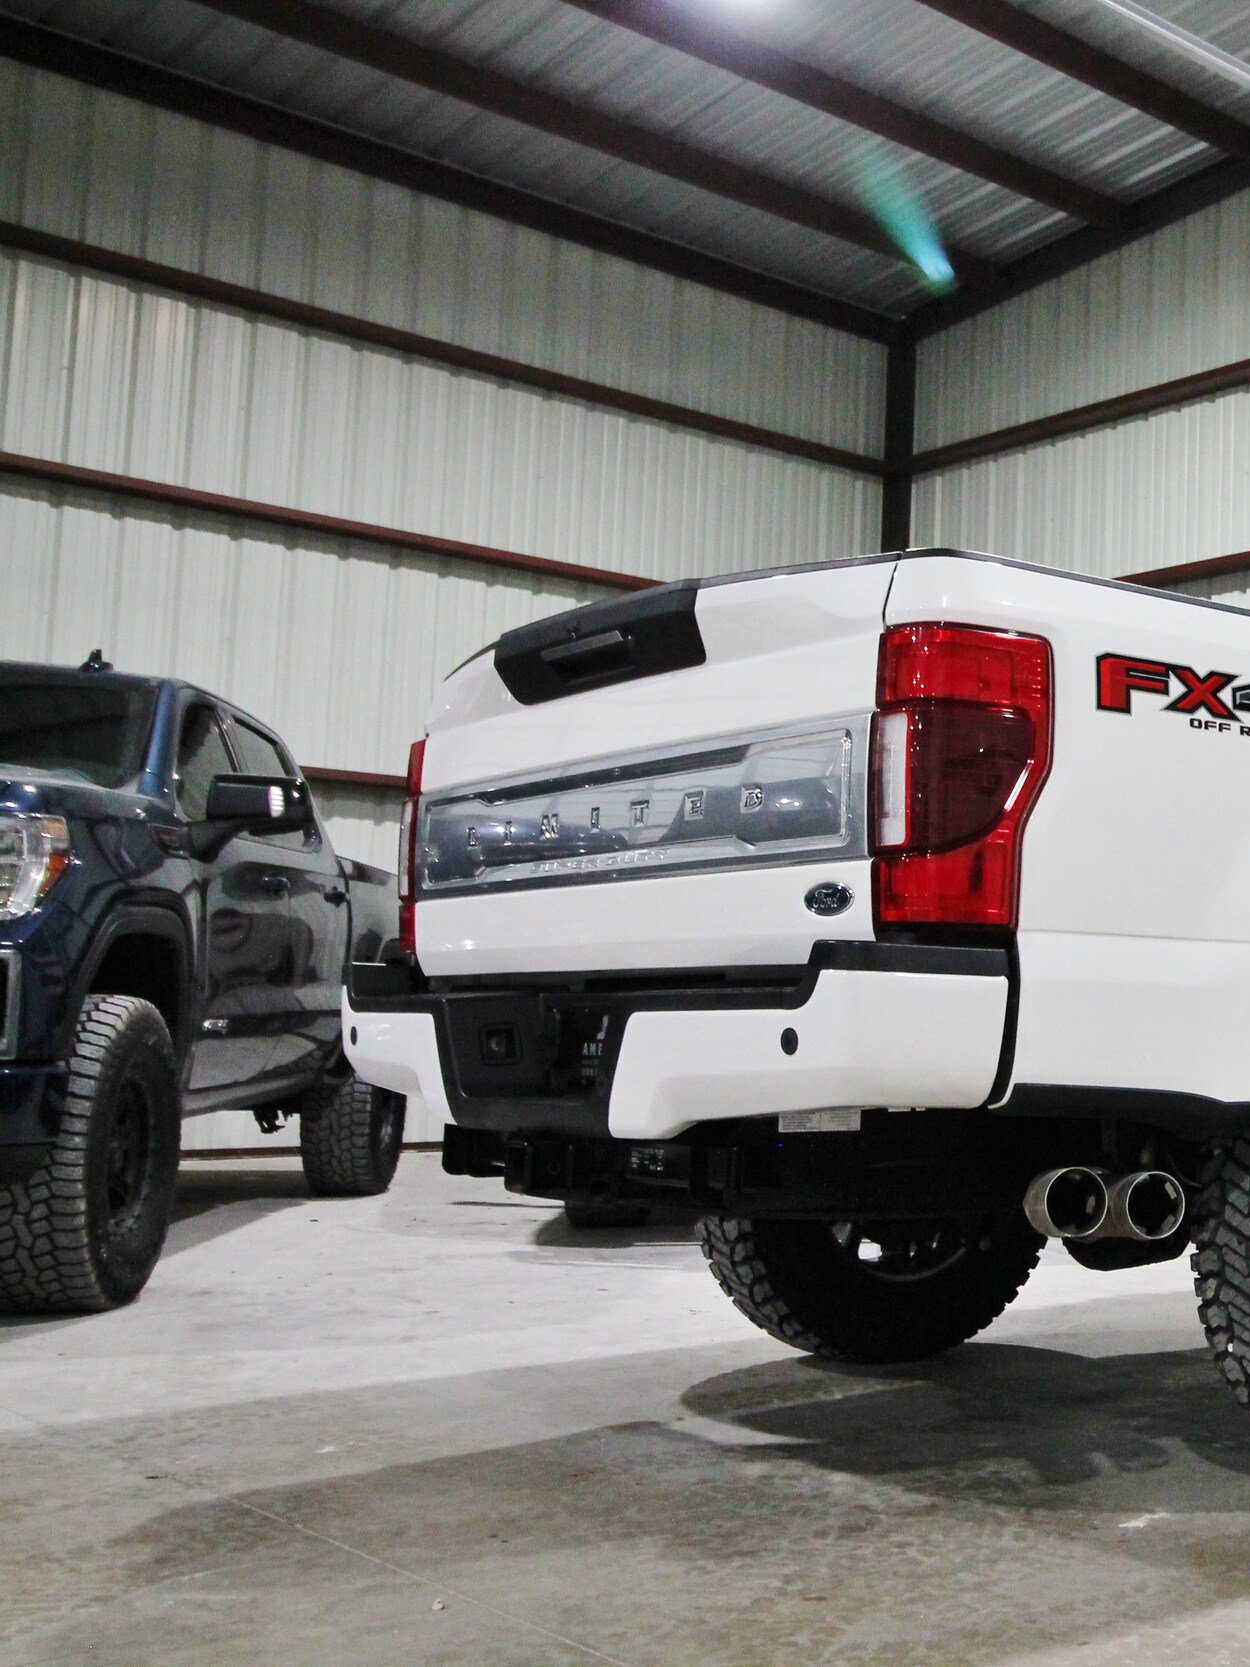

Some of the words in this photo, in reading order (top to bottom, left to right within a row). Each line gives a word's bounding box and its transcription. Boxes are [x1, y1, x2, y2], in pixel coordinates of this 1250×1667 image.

[1190, 718, 1232, 733] OFF
[467, 783, 763, 846] LIMITED
[812, 889, 840, 908] Ford
